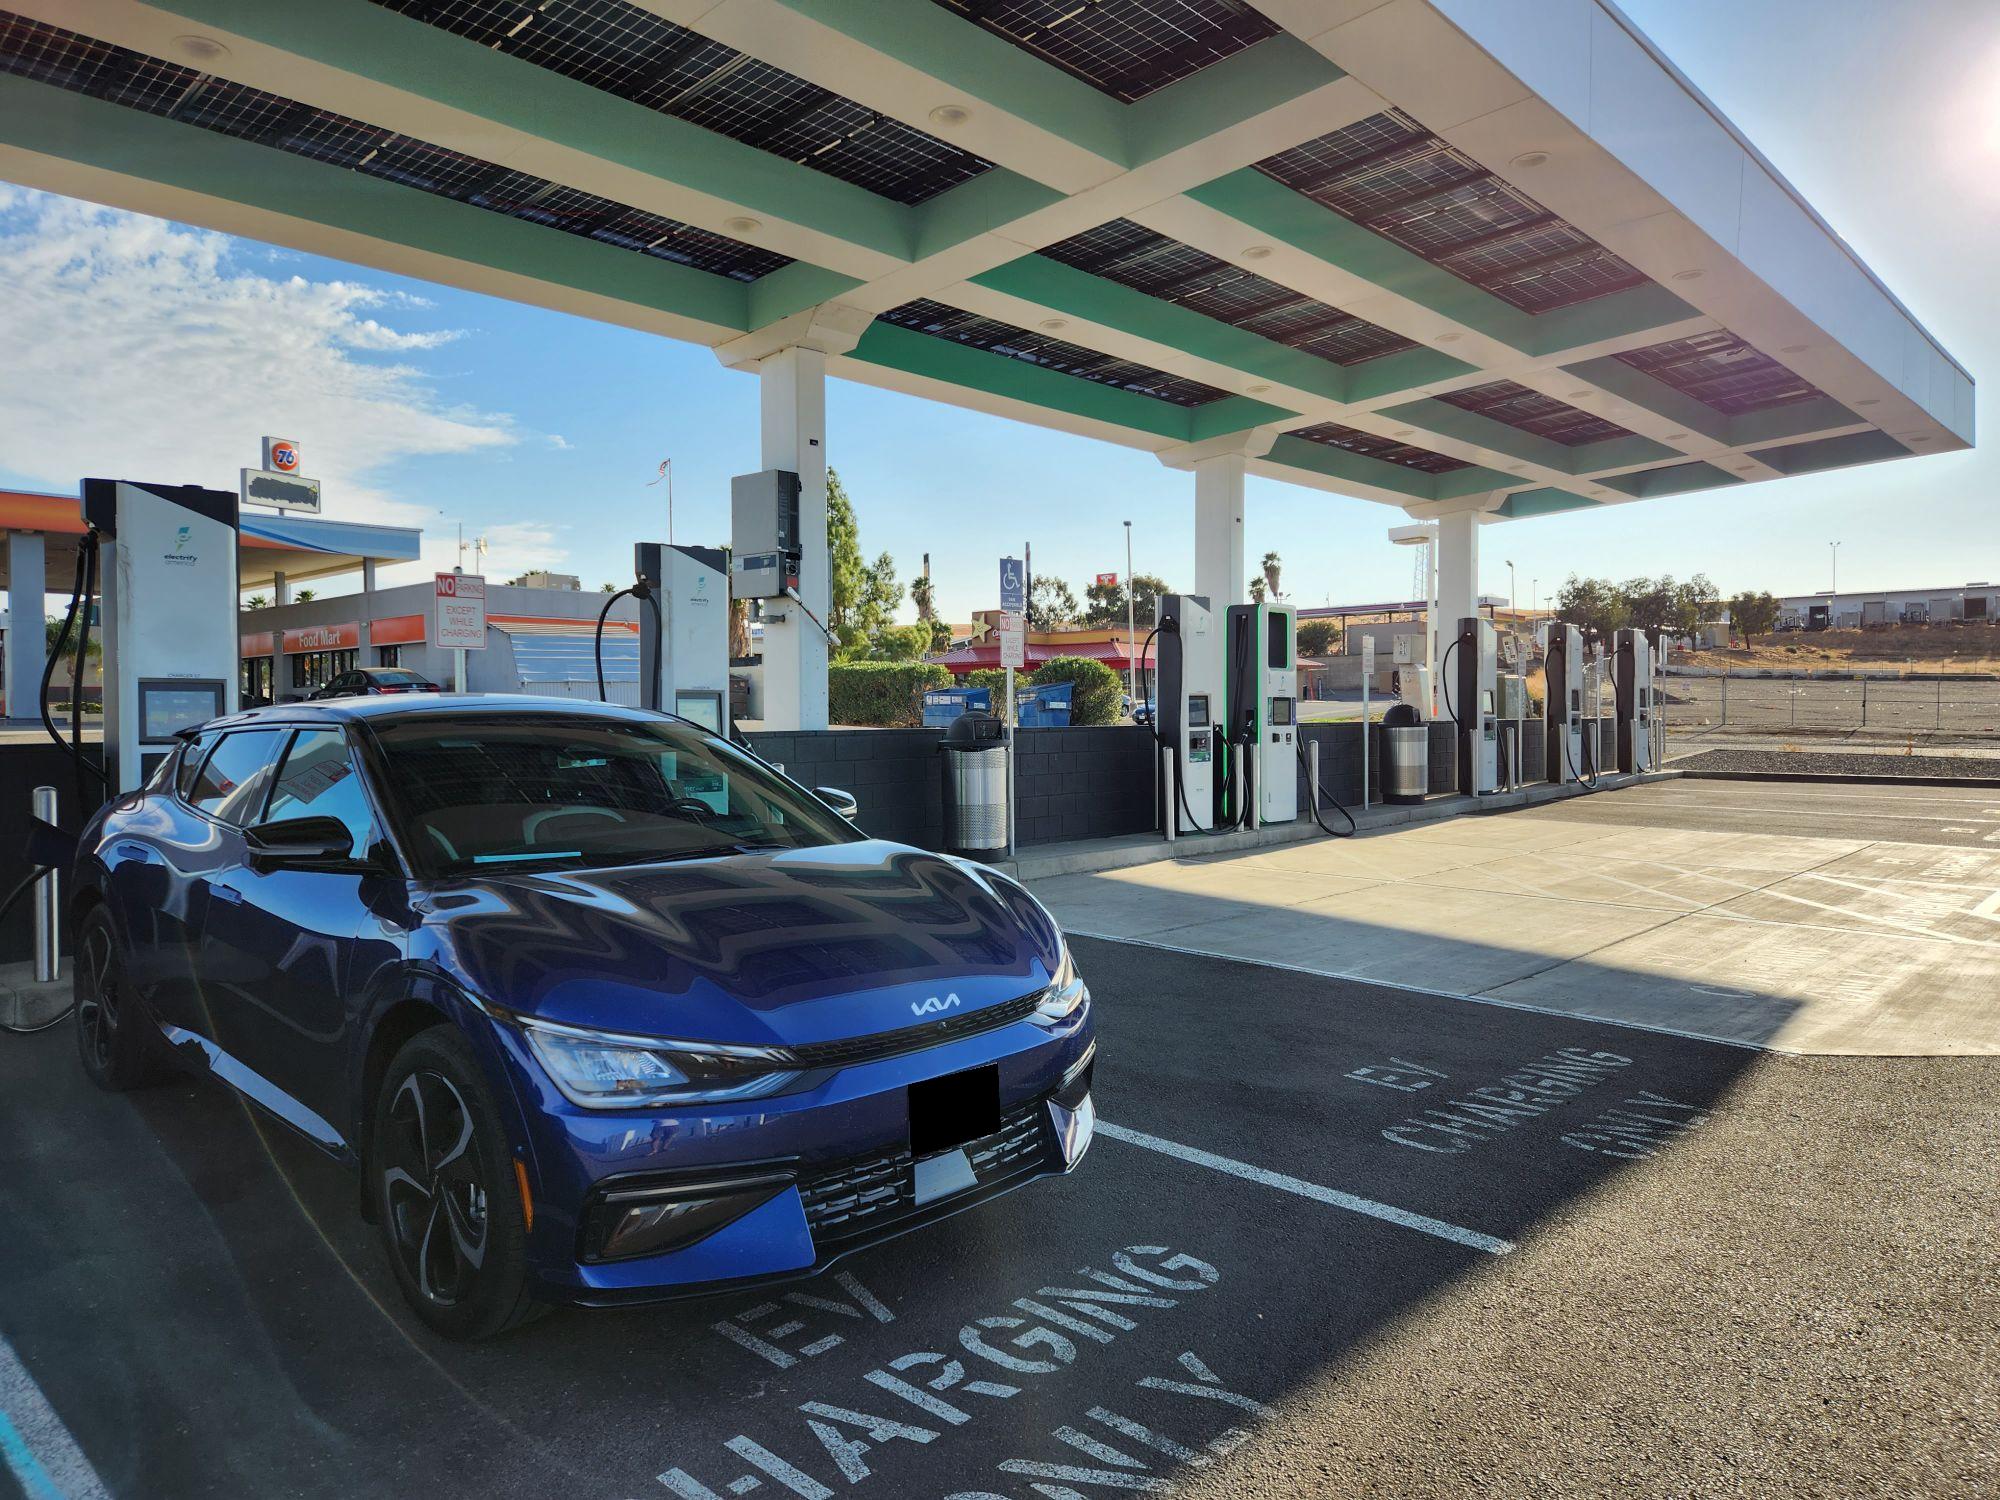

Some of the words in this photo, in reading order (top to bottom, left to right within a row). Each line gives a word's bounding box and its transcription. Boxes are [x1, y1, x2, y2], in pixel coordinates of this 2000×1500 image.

[277, 449, 295, 465] 76
[164, 554, 198, 562] electrify
[437, 577, 454, 594] NO
[456, 583, 483, 594] PARKING
[447, 606, 476, 615] EXCEPT
[449, 617, 474, 627] WHILE
[1001, 617, 1010, 630] NO
[299, 631, 319, 648] Food
[320, 629, 341, 645] Mart
[441, 628, 481, 638] CHARGING
[911, 993, 961, 1017] KIA
[1343, 1056, 1450, 1092] EV
[1381, 1047, 1634, 1153] CHARGING
[1560, 1089, 1716, 1159] ONLY
[709, 1270, 896, 1369] EV
[625, 1245, 1220, 1500] HARGING
